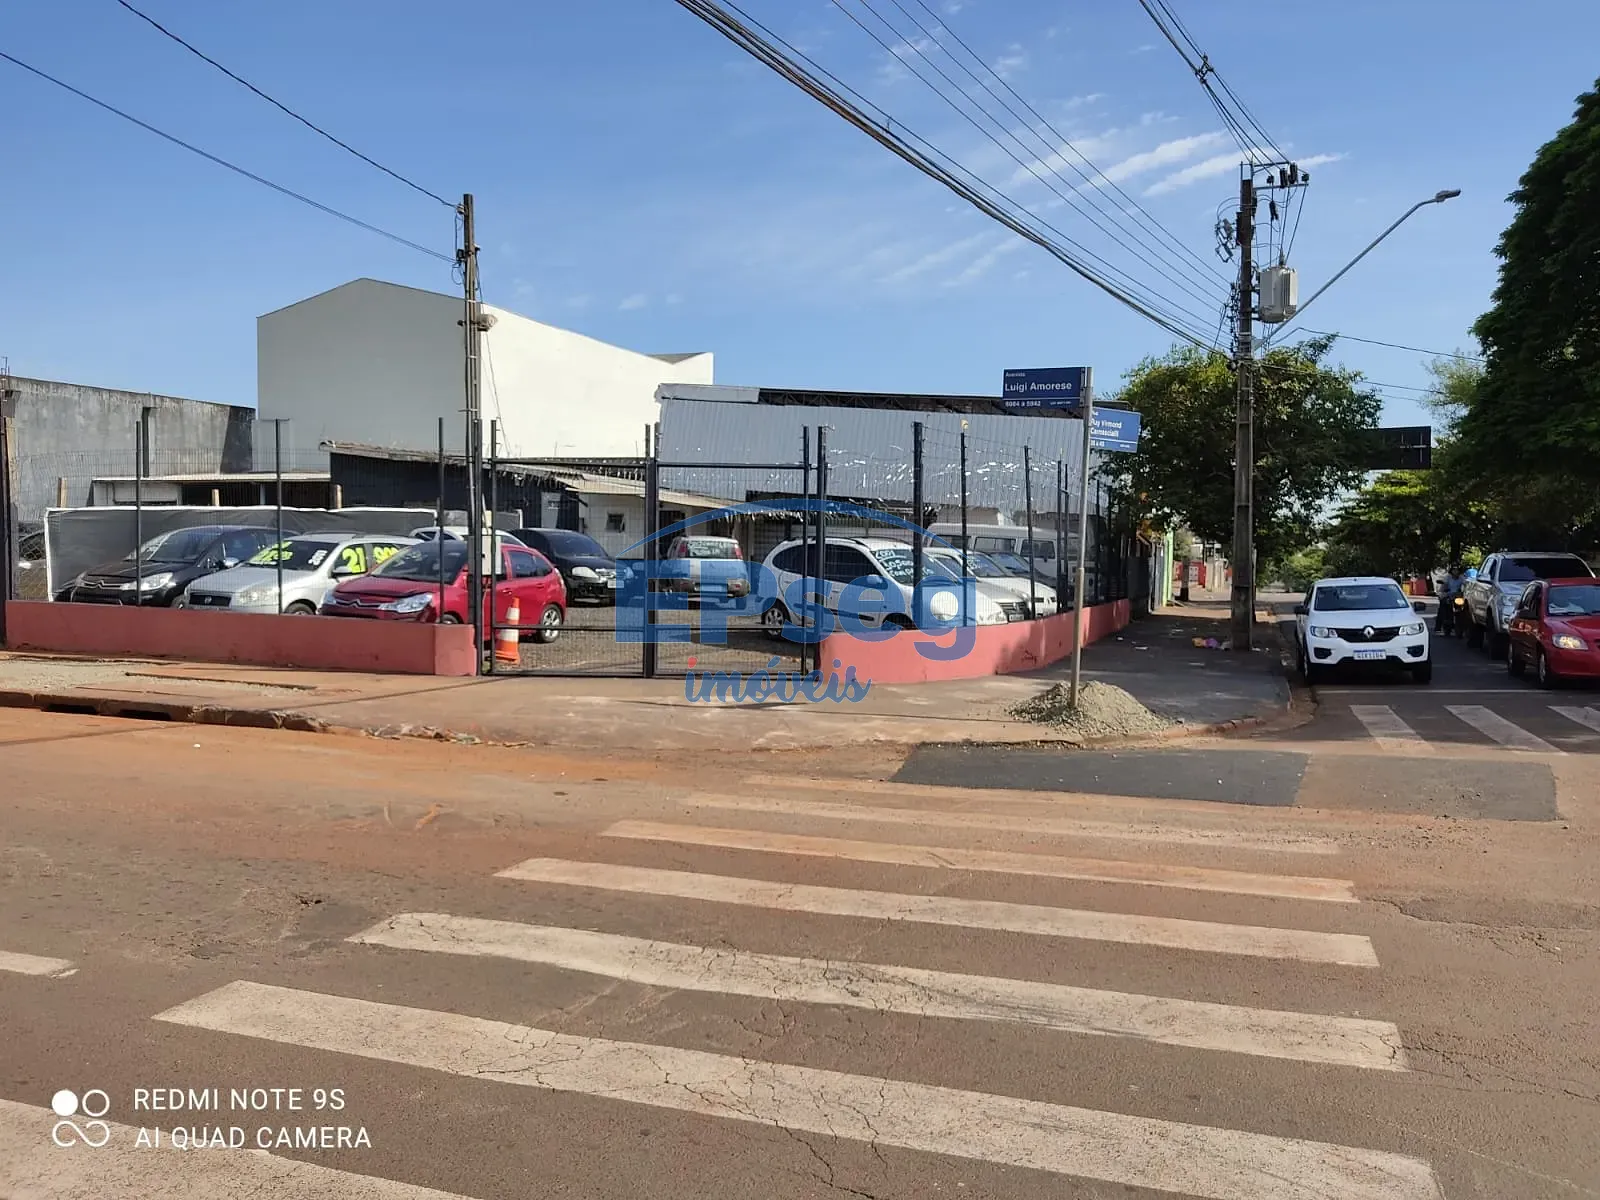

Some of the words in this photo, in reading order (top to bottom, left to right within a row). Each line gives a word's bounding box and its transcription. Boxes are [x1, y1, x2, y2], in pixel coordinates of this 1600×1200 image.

[1004, 381, 1028, 393] Luigi
[1030, 382, 1073, 391] Amorese
[341, 547, 366, 573] 21
